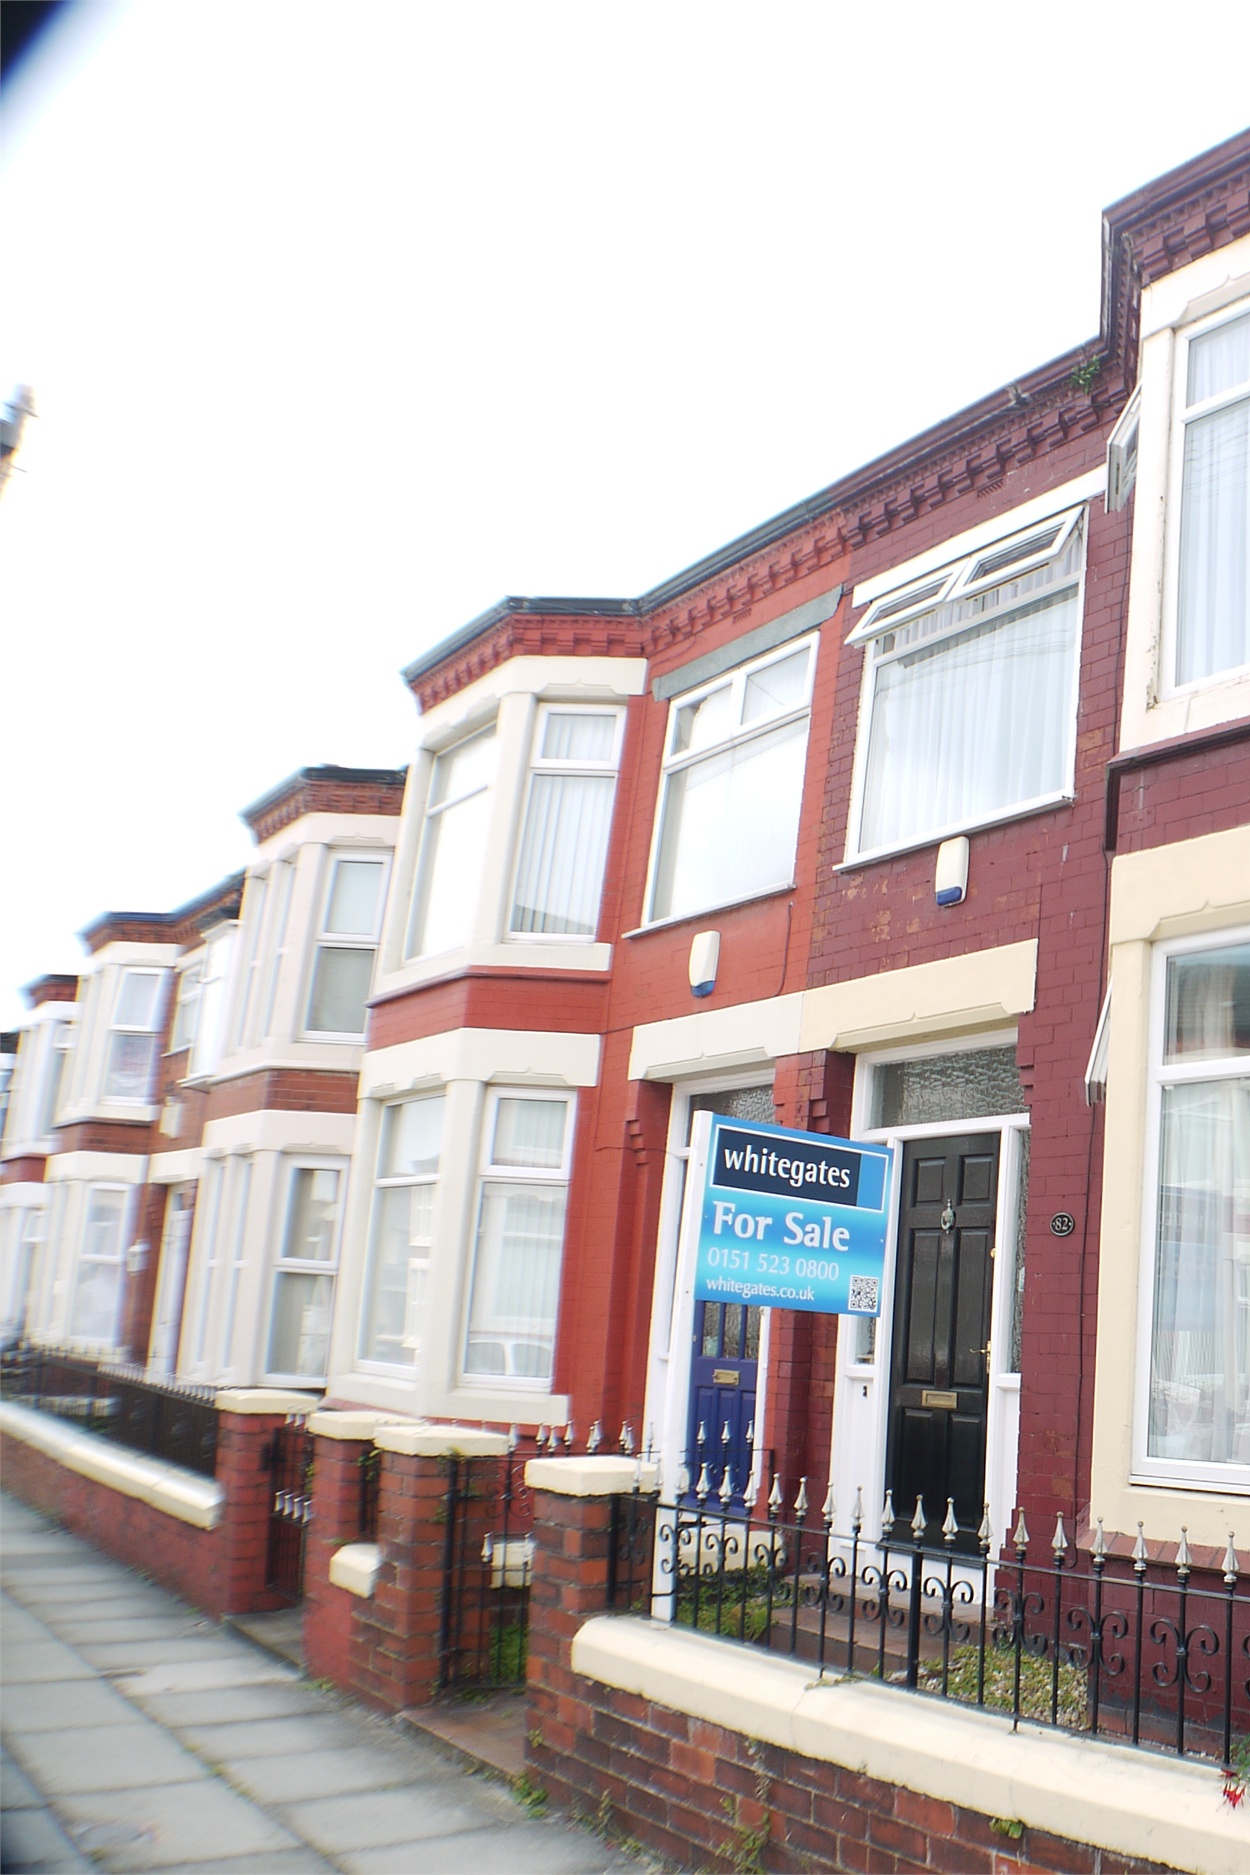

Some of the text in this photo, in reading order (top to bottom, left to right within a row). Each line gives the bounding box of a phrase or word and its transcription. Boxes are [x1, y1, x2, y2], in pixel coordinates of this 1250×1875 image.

[723, 1144, 851, 1189] whitegates
[712, 1200, 851, 1252] For Sale
[1055, 1217, 1069, 1231] 82
[707, 1246, 840, 1281] 0151 523 0800
[705, 1275, 815, 1301] whitegates.co.uk
